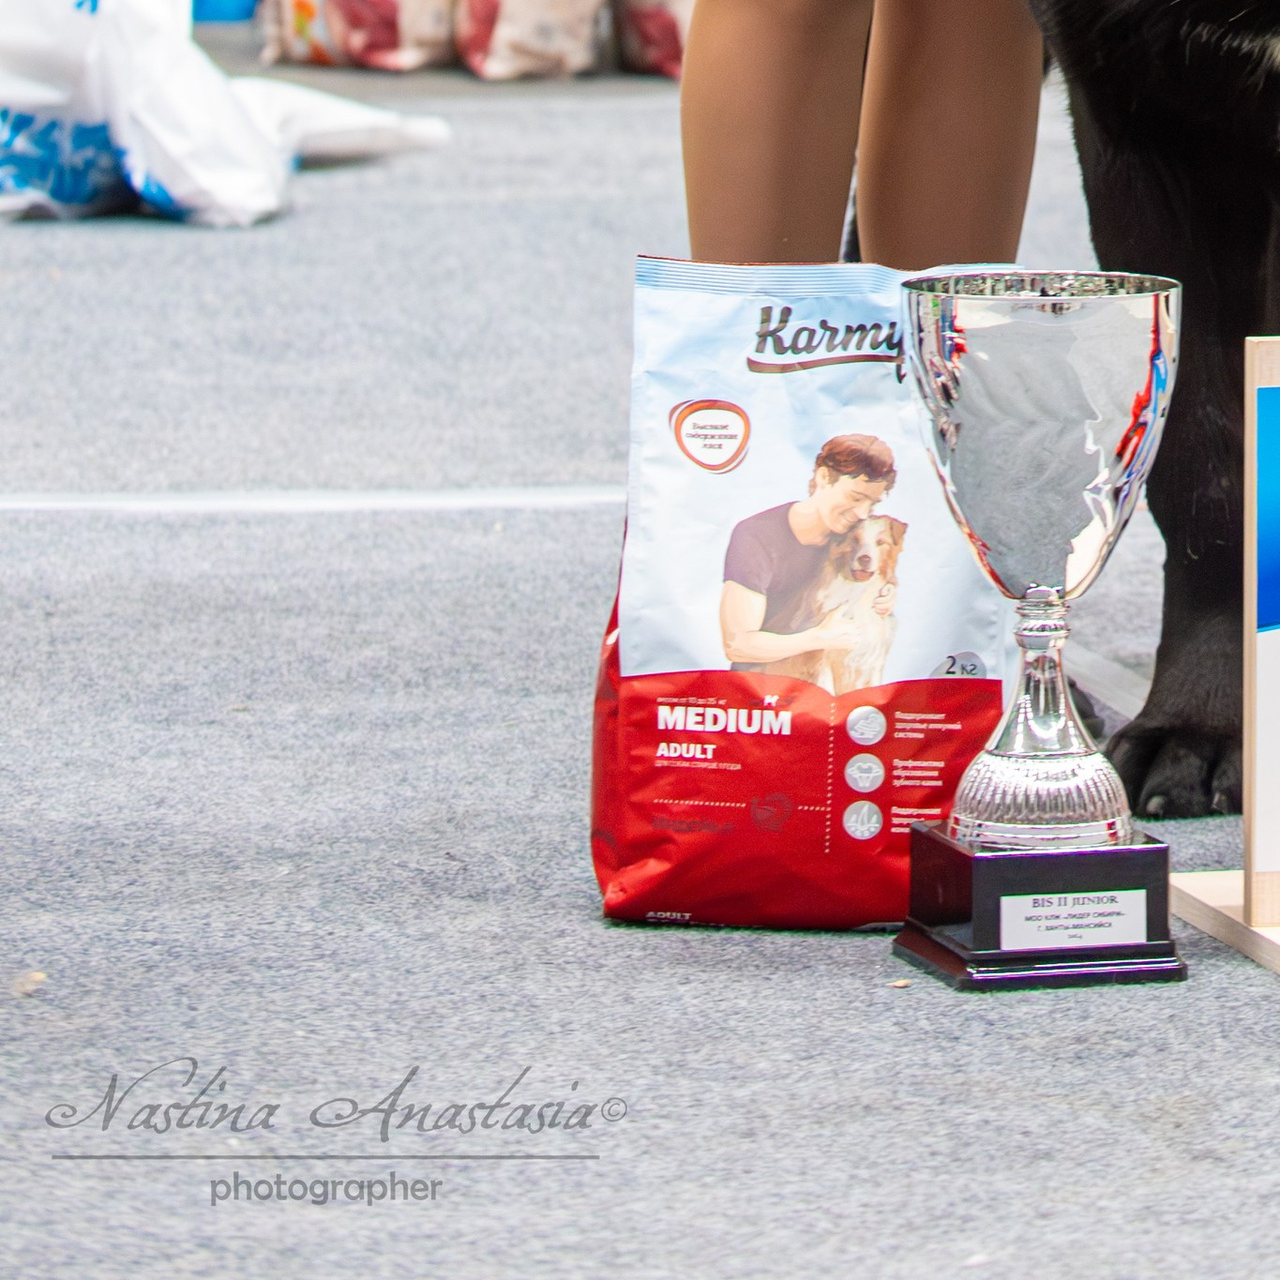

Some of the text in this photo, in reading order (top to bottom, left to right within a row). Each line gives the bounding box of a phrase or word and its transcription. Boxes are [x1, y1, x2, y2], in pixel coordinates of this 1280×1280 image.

[945, 655, 957, 675] 2
[657, 705, 792, 736] MEDIUM
[655, 742, 716, 759] ADULT
[1032, 895, 1119, 909] BIS II JUNIOR
[646, 911, 692, 920] ADULT
